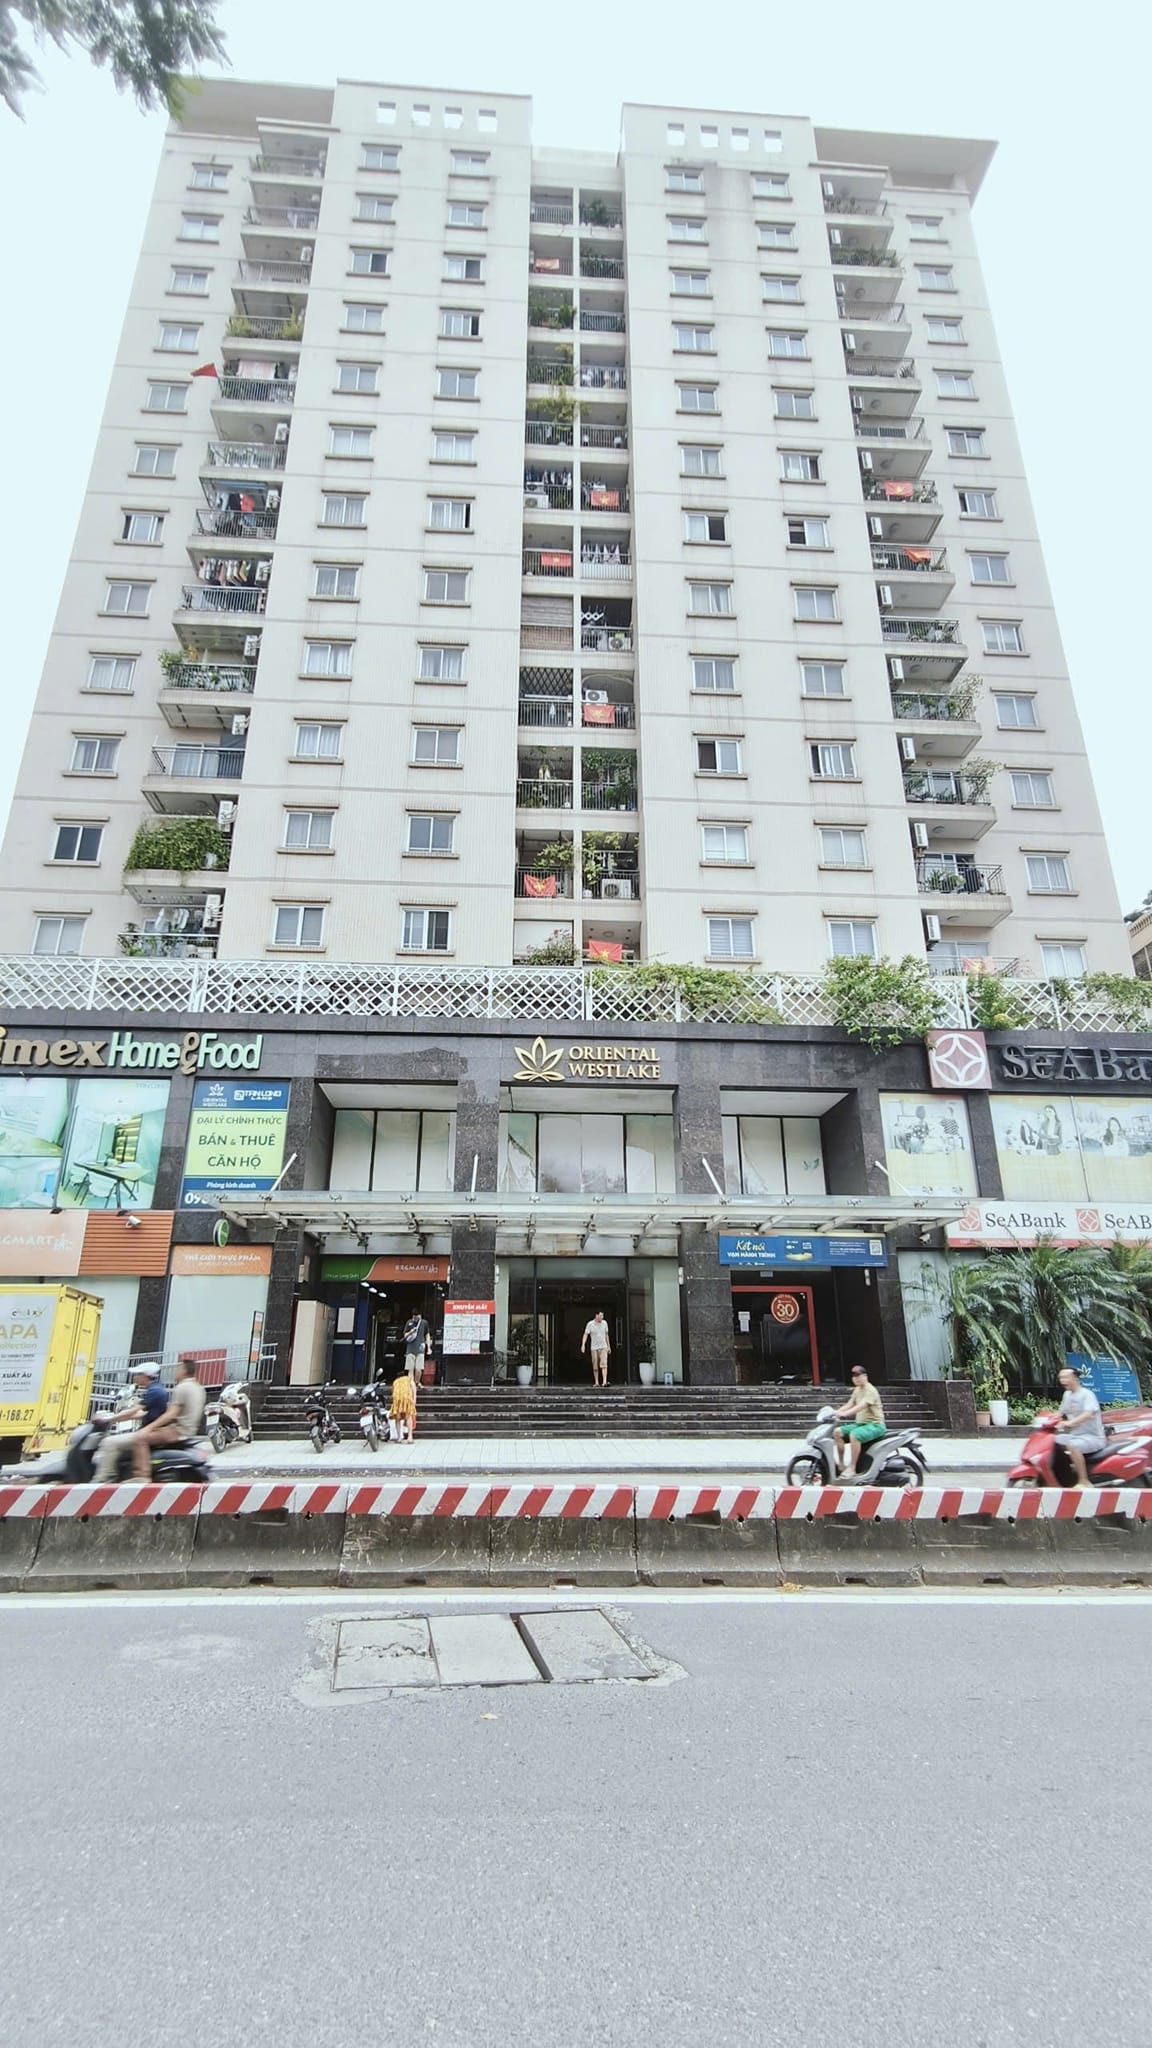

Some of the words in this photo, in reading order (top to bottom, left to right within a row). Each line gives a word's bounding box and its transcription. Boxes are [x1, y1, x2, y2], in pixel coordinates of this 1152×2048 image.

[568, 1046, 661, 1062] ORIENTAL
[568, 1063, 661, 1080] WESTLAKE
[214, 1115, 225, 1125] LÝ
[226, 1115, 254, 1125] CHÍNH
[256, 1116, 283, 1126] THỨC
[198, 1132, 228, 1145] BÁN
[239, 1133, 276, 1146] THUÊ
[239, 1153, 262, 1169] HỘ
[985, 1211, 1067, 1229] SeABank
[1104, 1213, 1152, 1230] SeAB
[777, 1303, 794, 1317] 30
